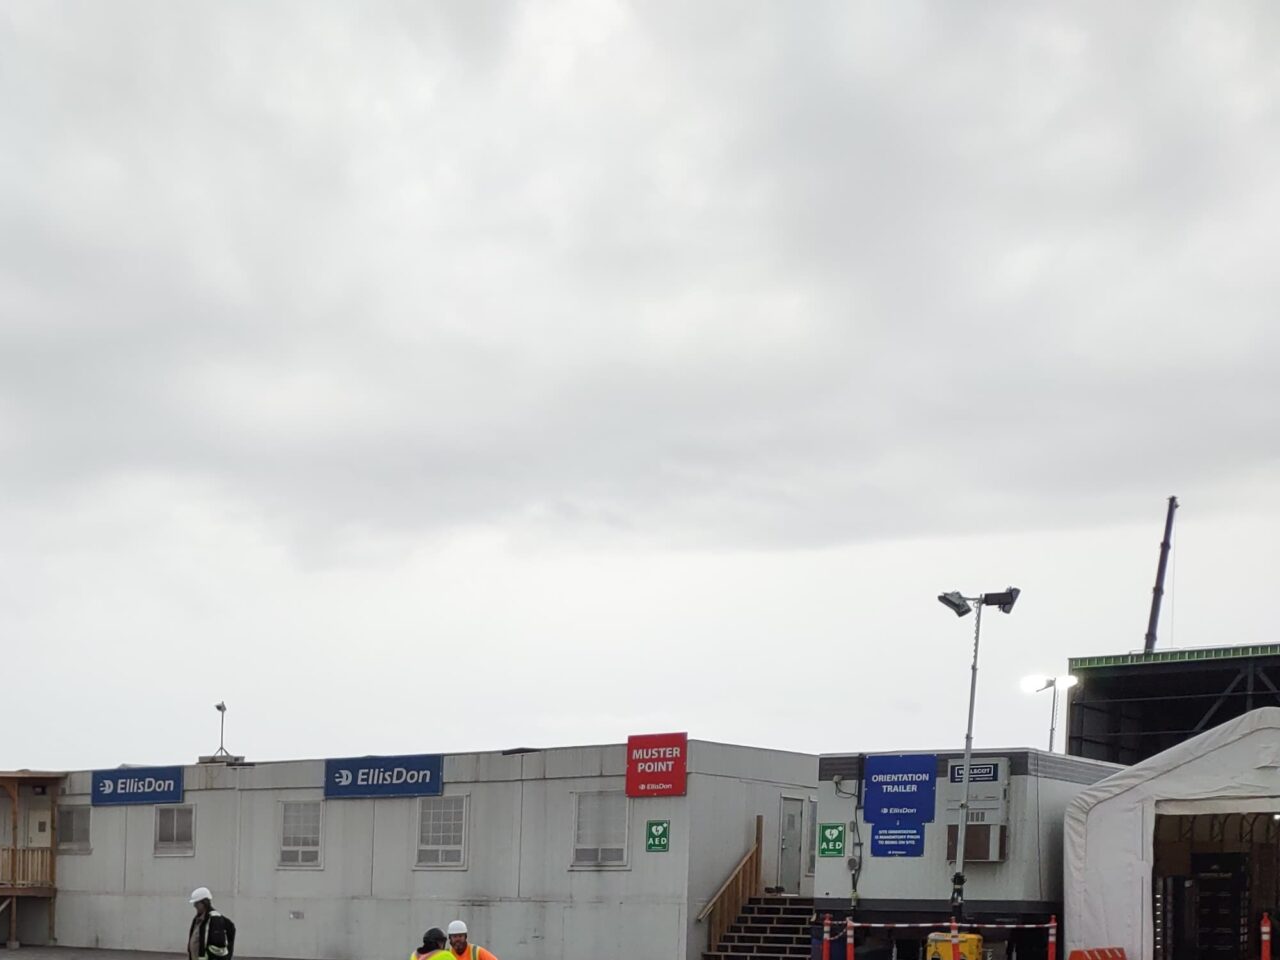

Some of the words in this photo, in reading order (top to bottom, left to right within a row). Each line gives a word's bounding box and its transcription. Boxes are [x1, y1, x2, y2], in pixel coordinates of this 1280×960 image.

[632, 747, 681, 760] MUSTER
[637, 761, 675, 773] POINT
[357, 767, 431, 785] EllisDon
[871, 773, 929, 783] ORIENTATION
[117, 777, 174, 794] EllisDon
[882, 784, 918, 793] TRAILER
[647, 837, 668, 845] AED
[821, 841, 843, 850] AED
